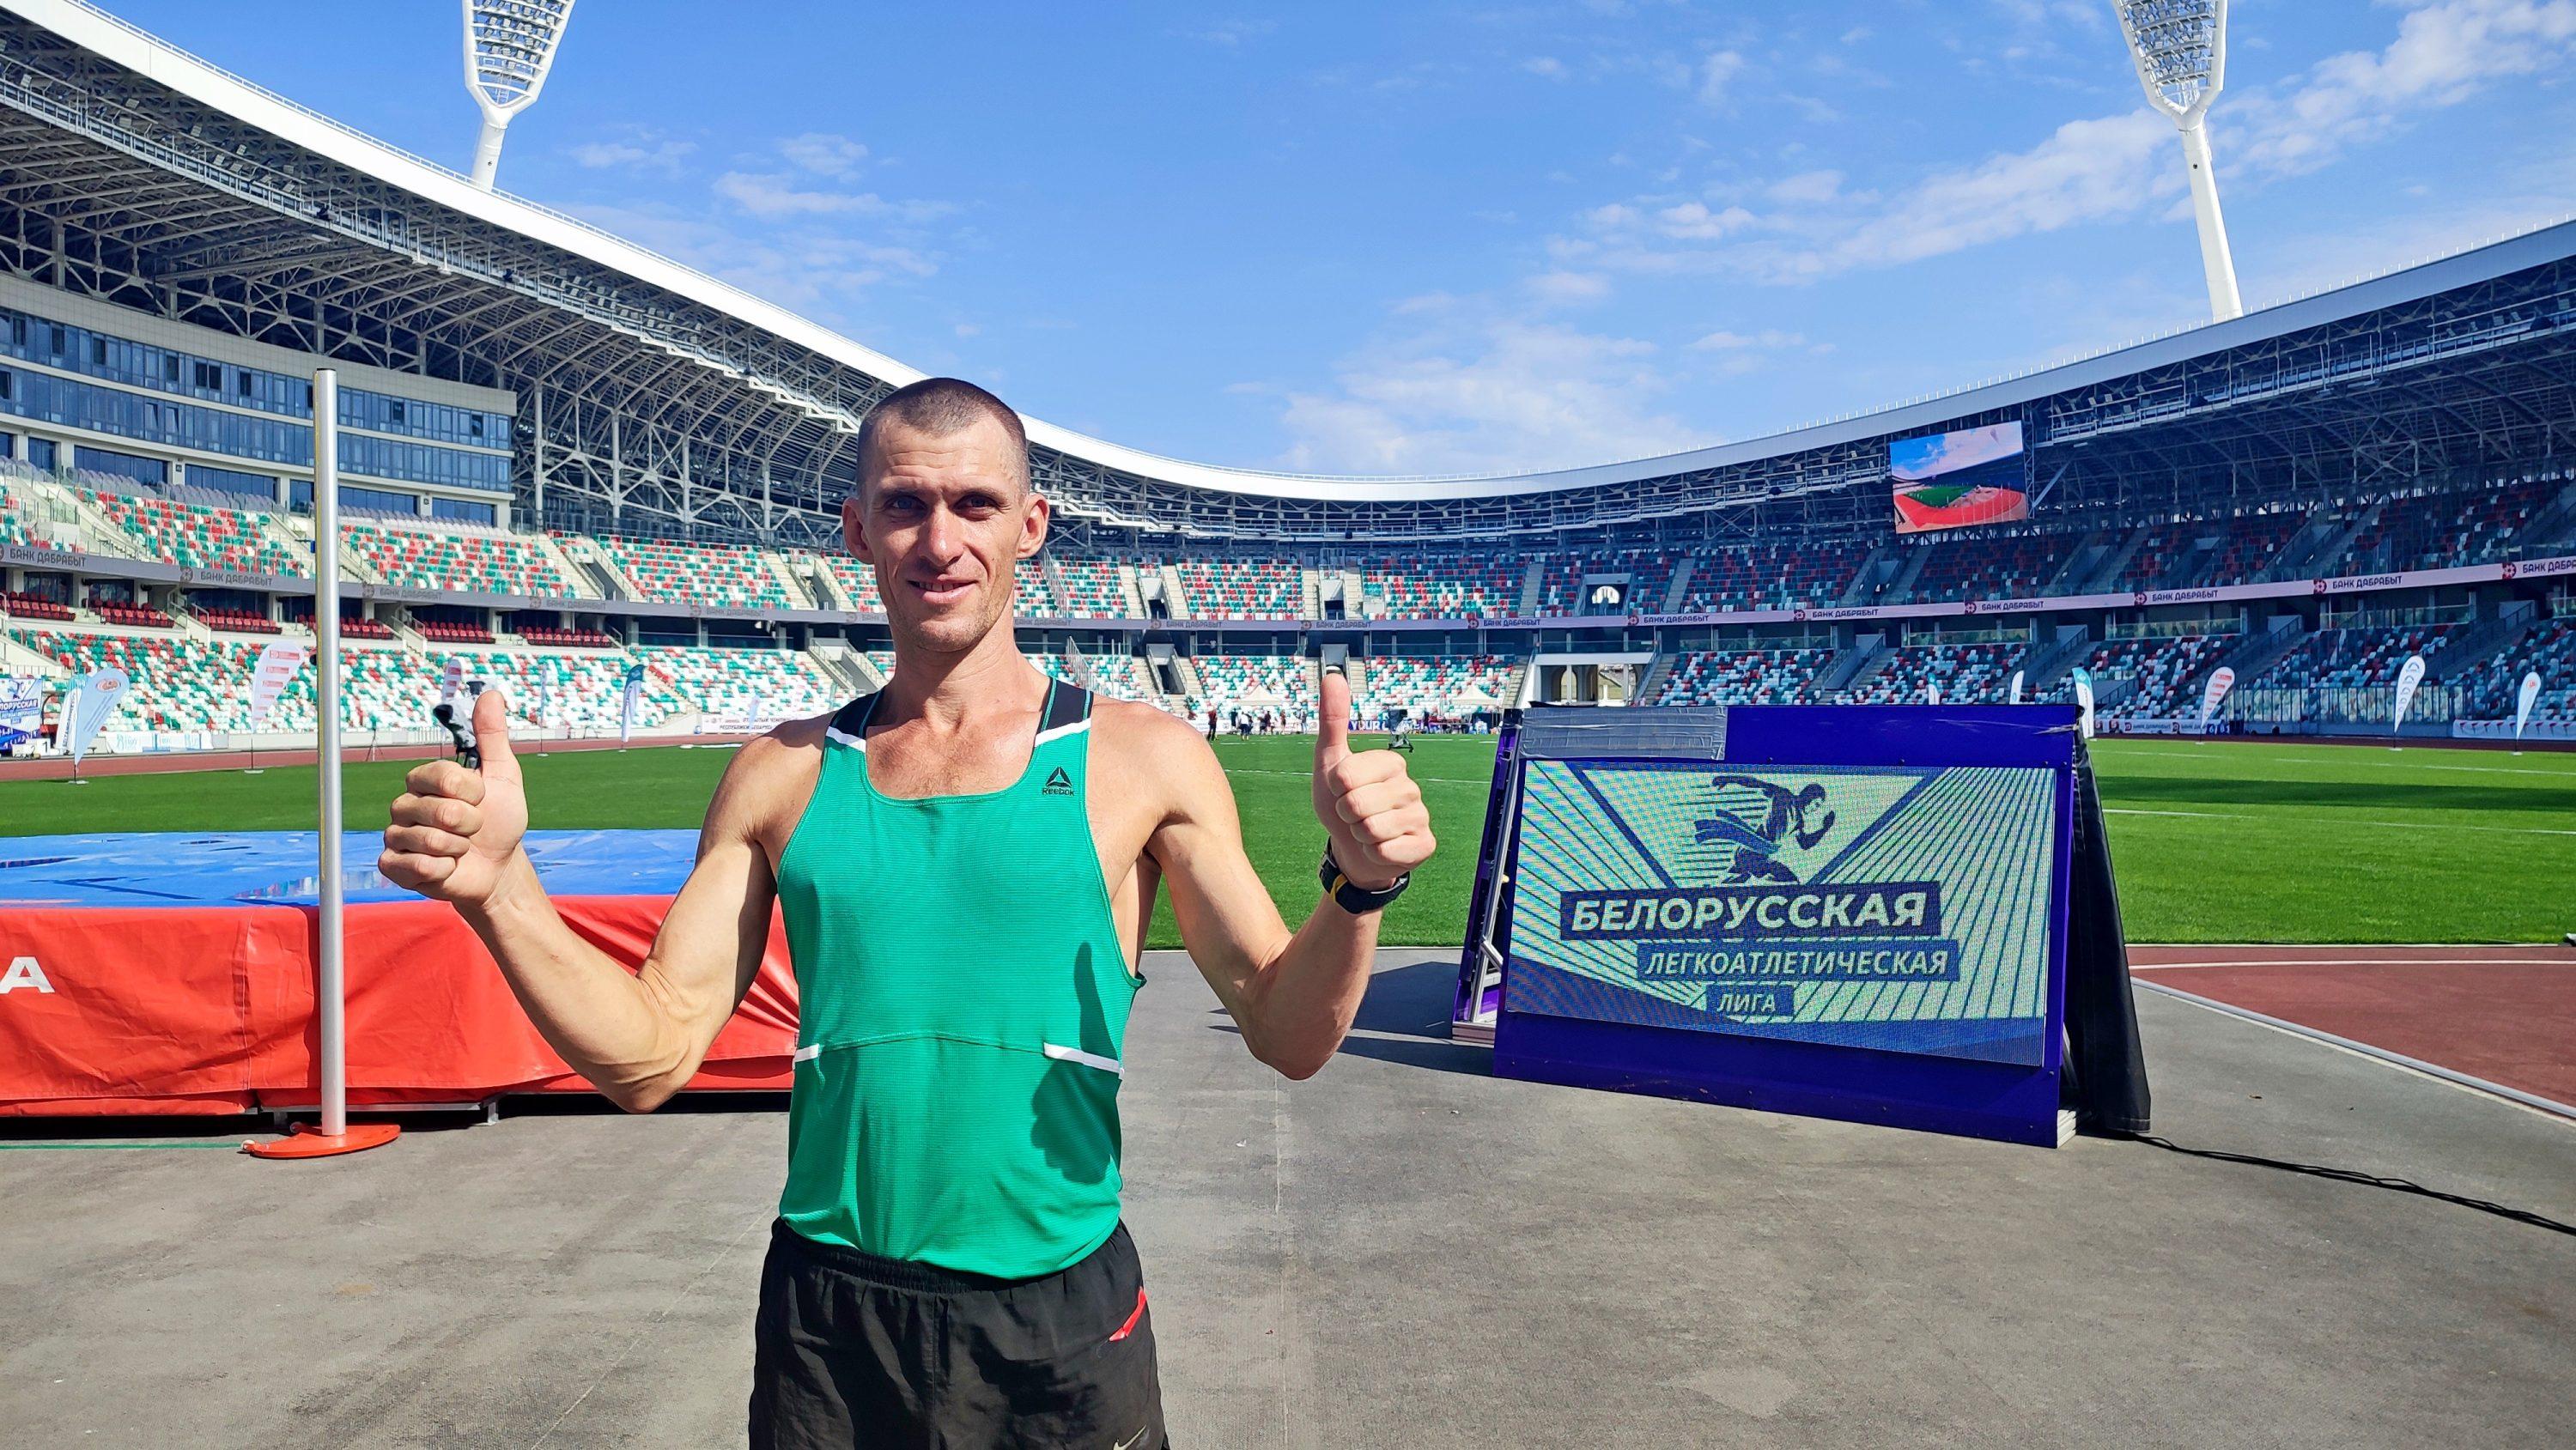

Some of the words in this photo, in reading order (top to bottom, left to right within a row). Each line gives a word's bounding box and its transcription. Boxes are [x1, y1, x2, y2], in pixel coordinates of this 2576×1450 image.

[9, 548, 34, 561] БАНК
[37, 551, 86, 567] ДАБРАБЫТ
[2522, 562, 2546, 573] БАНК
[200, 571, 224, 582] БАНК
[225, 573, 273, 587] ДАБРАБЫТ
[2332, 579, 2354, 589] БАНК
[2356, 576, 2402, 588] ДАБРАБЫТ
[2152, 593, 2173, 602] БАНК
[2174, 590, 2218, 601] ДАБРАБЫТ
[1981, 603, 2002, 611] БАНК
[2003, 601, 2044, 610] ДАБРАБЫТ
[1666, 615, 1710, 623] ДАБРАБЫТ
[1835, 609, 1879, 618] ДАБРАБЫТ
[42, 741, 48, 753] 1
[1042, 787, 1074, 797] Reebok
[1571, 891, 1927, 931] БЕЛОРУССКАЯ
[1645, 949, 1949, 976] ЛЕГКОАТЛЕТИЧЕСКАЯ
[1716, 990, 1777, 1014] ЛИГА
